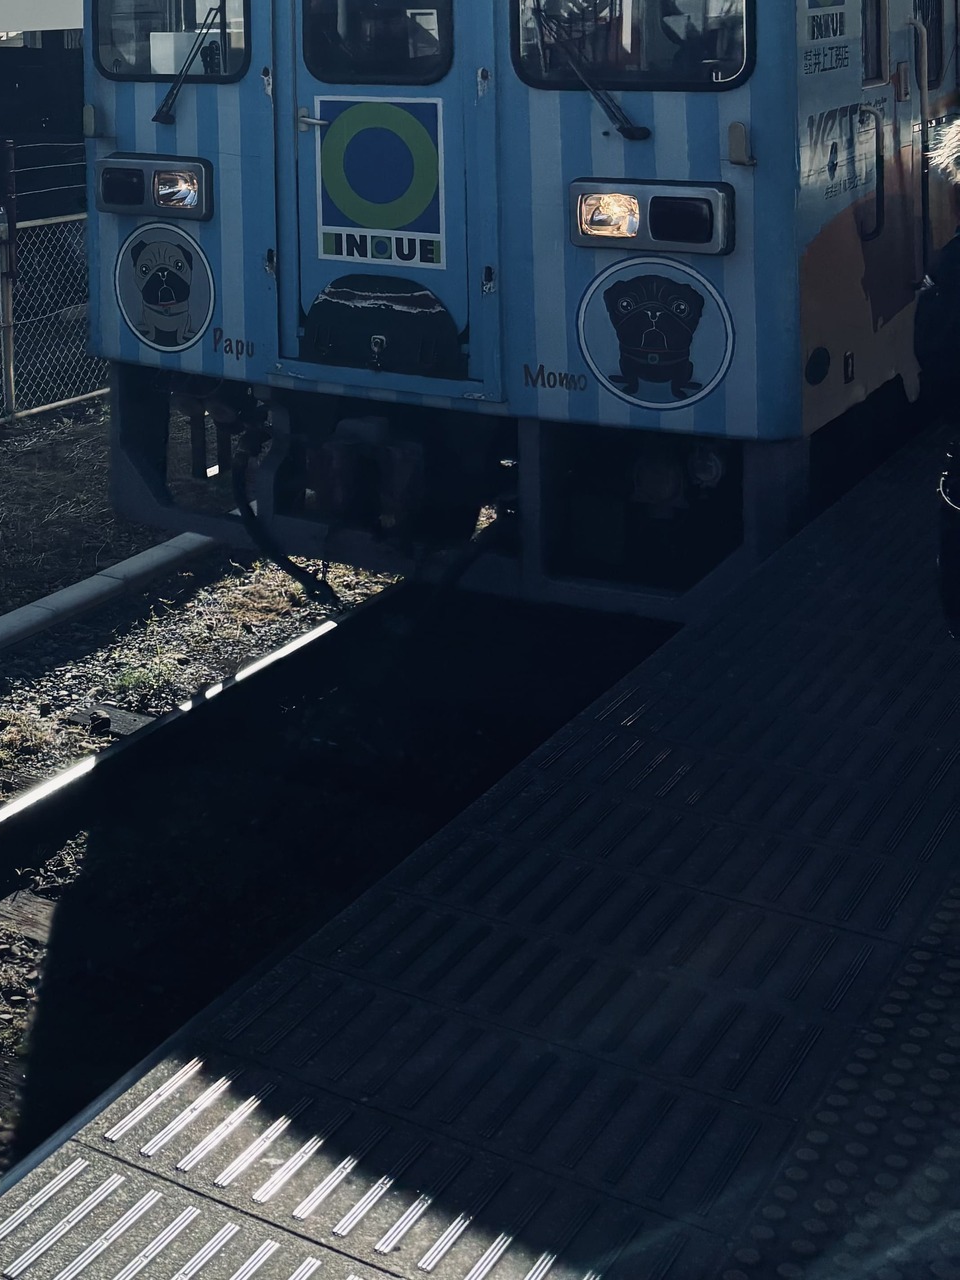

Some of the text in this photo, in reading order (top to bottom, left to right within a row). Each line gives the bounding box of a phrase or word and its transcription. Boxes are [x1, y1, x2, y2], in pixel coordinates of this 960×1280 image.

[323, 232, 441, 264] INOUE
[213, 327, 255, 361] Papu
[523, 363, 588, 392] Momo
